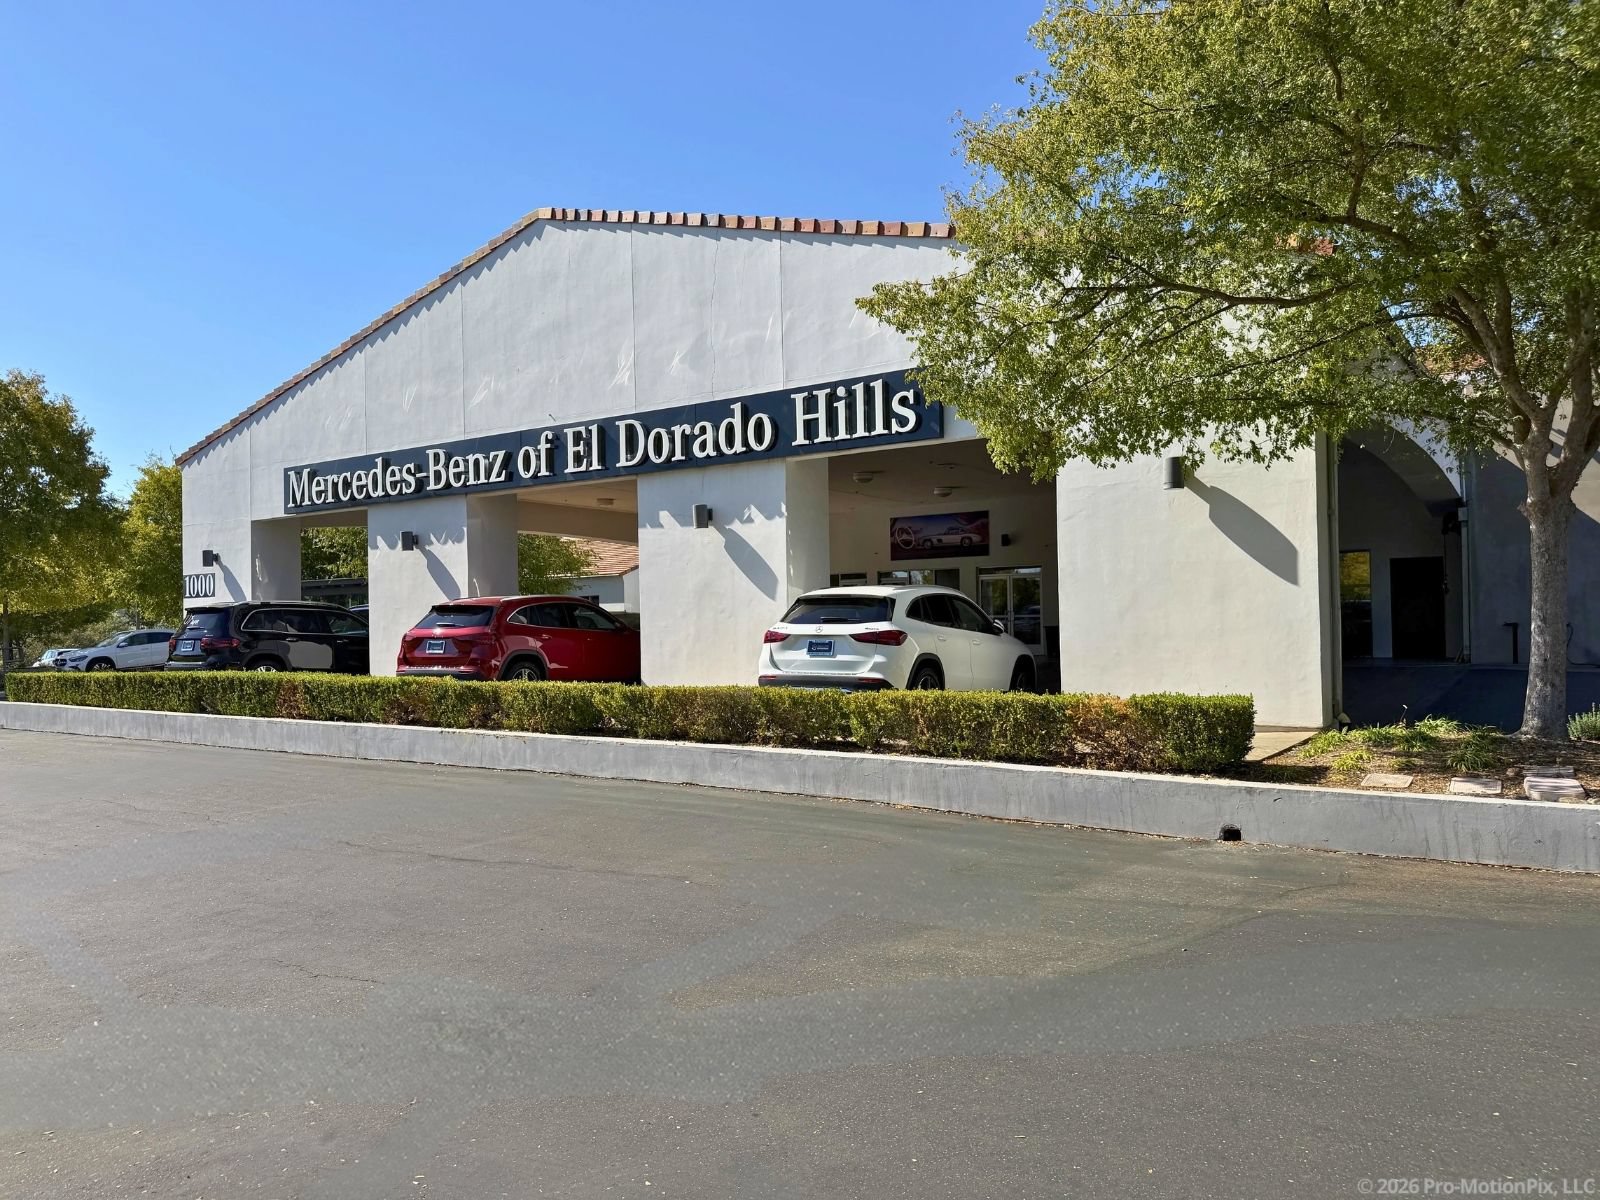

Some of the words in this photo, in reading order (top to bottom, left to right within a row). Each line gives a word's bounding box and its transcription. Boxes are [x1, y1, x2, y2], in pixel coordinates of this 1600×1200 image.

[287, 449, 506, 508] Mercedes-Benz
[517, 430, 556, 479] of
[564, 423, 605, 473] El
[615, 402, 774, 468] Dorado
[790, 378, 917, 446] Hills
[184, 574, 214, 597] 1000
